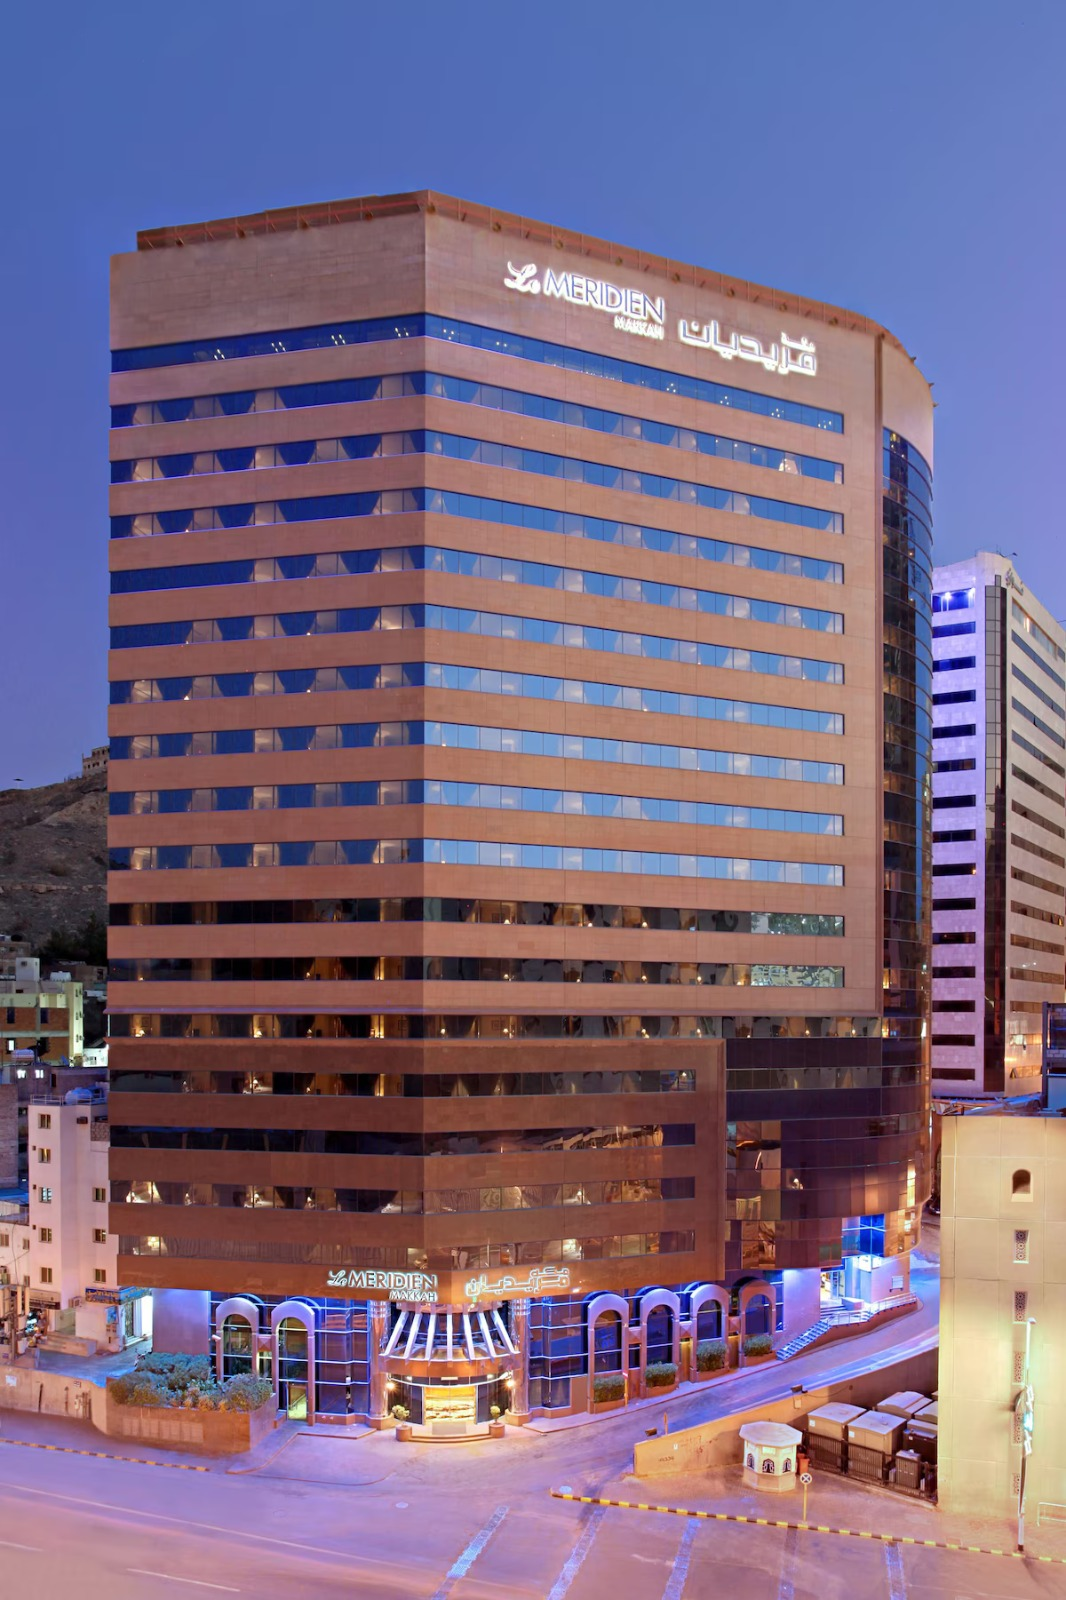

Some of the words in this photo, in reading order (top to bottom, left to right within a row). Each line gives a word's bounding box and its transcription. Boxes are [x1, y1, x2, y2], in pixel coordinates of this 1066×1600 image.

[503, 261, 541, 294] Le
[544, 268, 665, 325] MERIDIEN
[614, 315, 664, 340] MAKKAH
[678, 319, 816, 376] مريديان
[327, 1269, 347, 1287] Le
[348, 1270, 438, 1291] MERIDIEN
[465, 1274, 569, 1297] مريديان
[389, 1290, 438, 1302] MAKKAH
